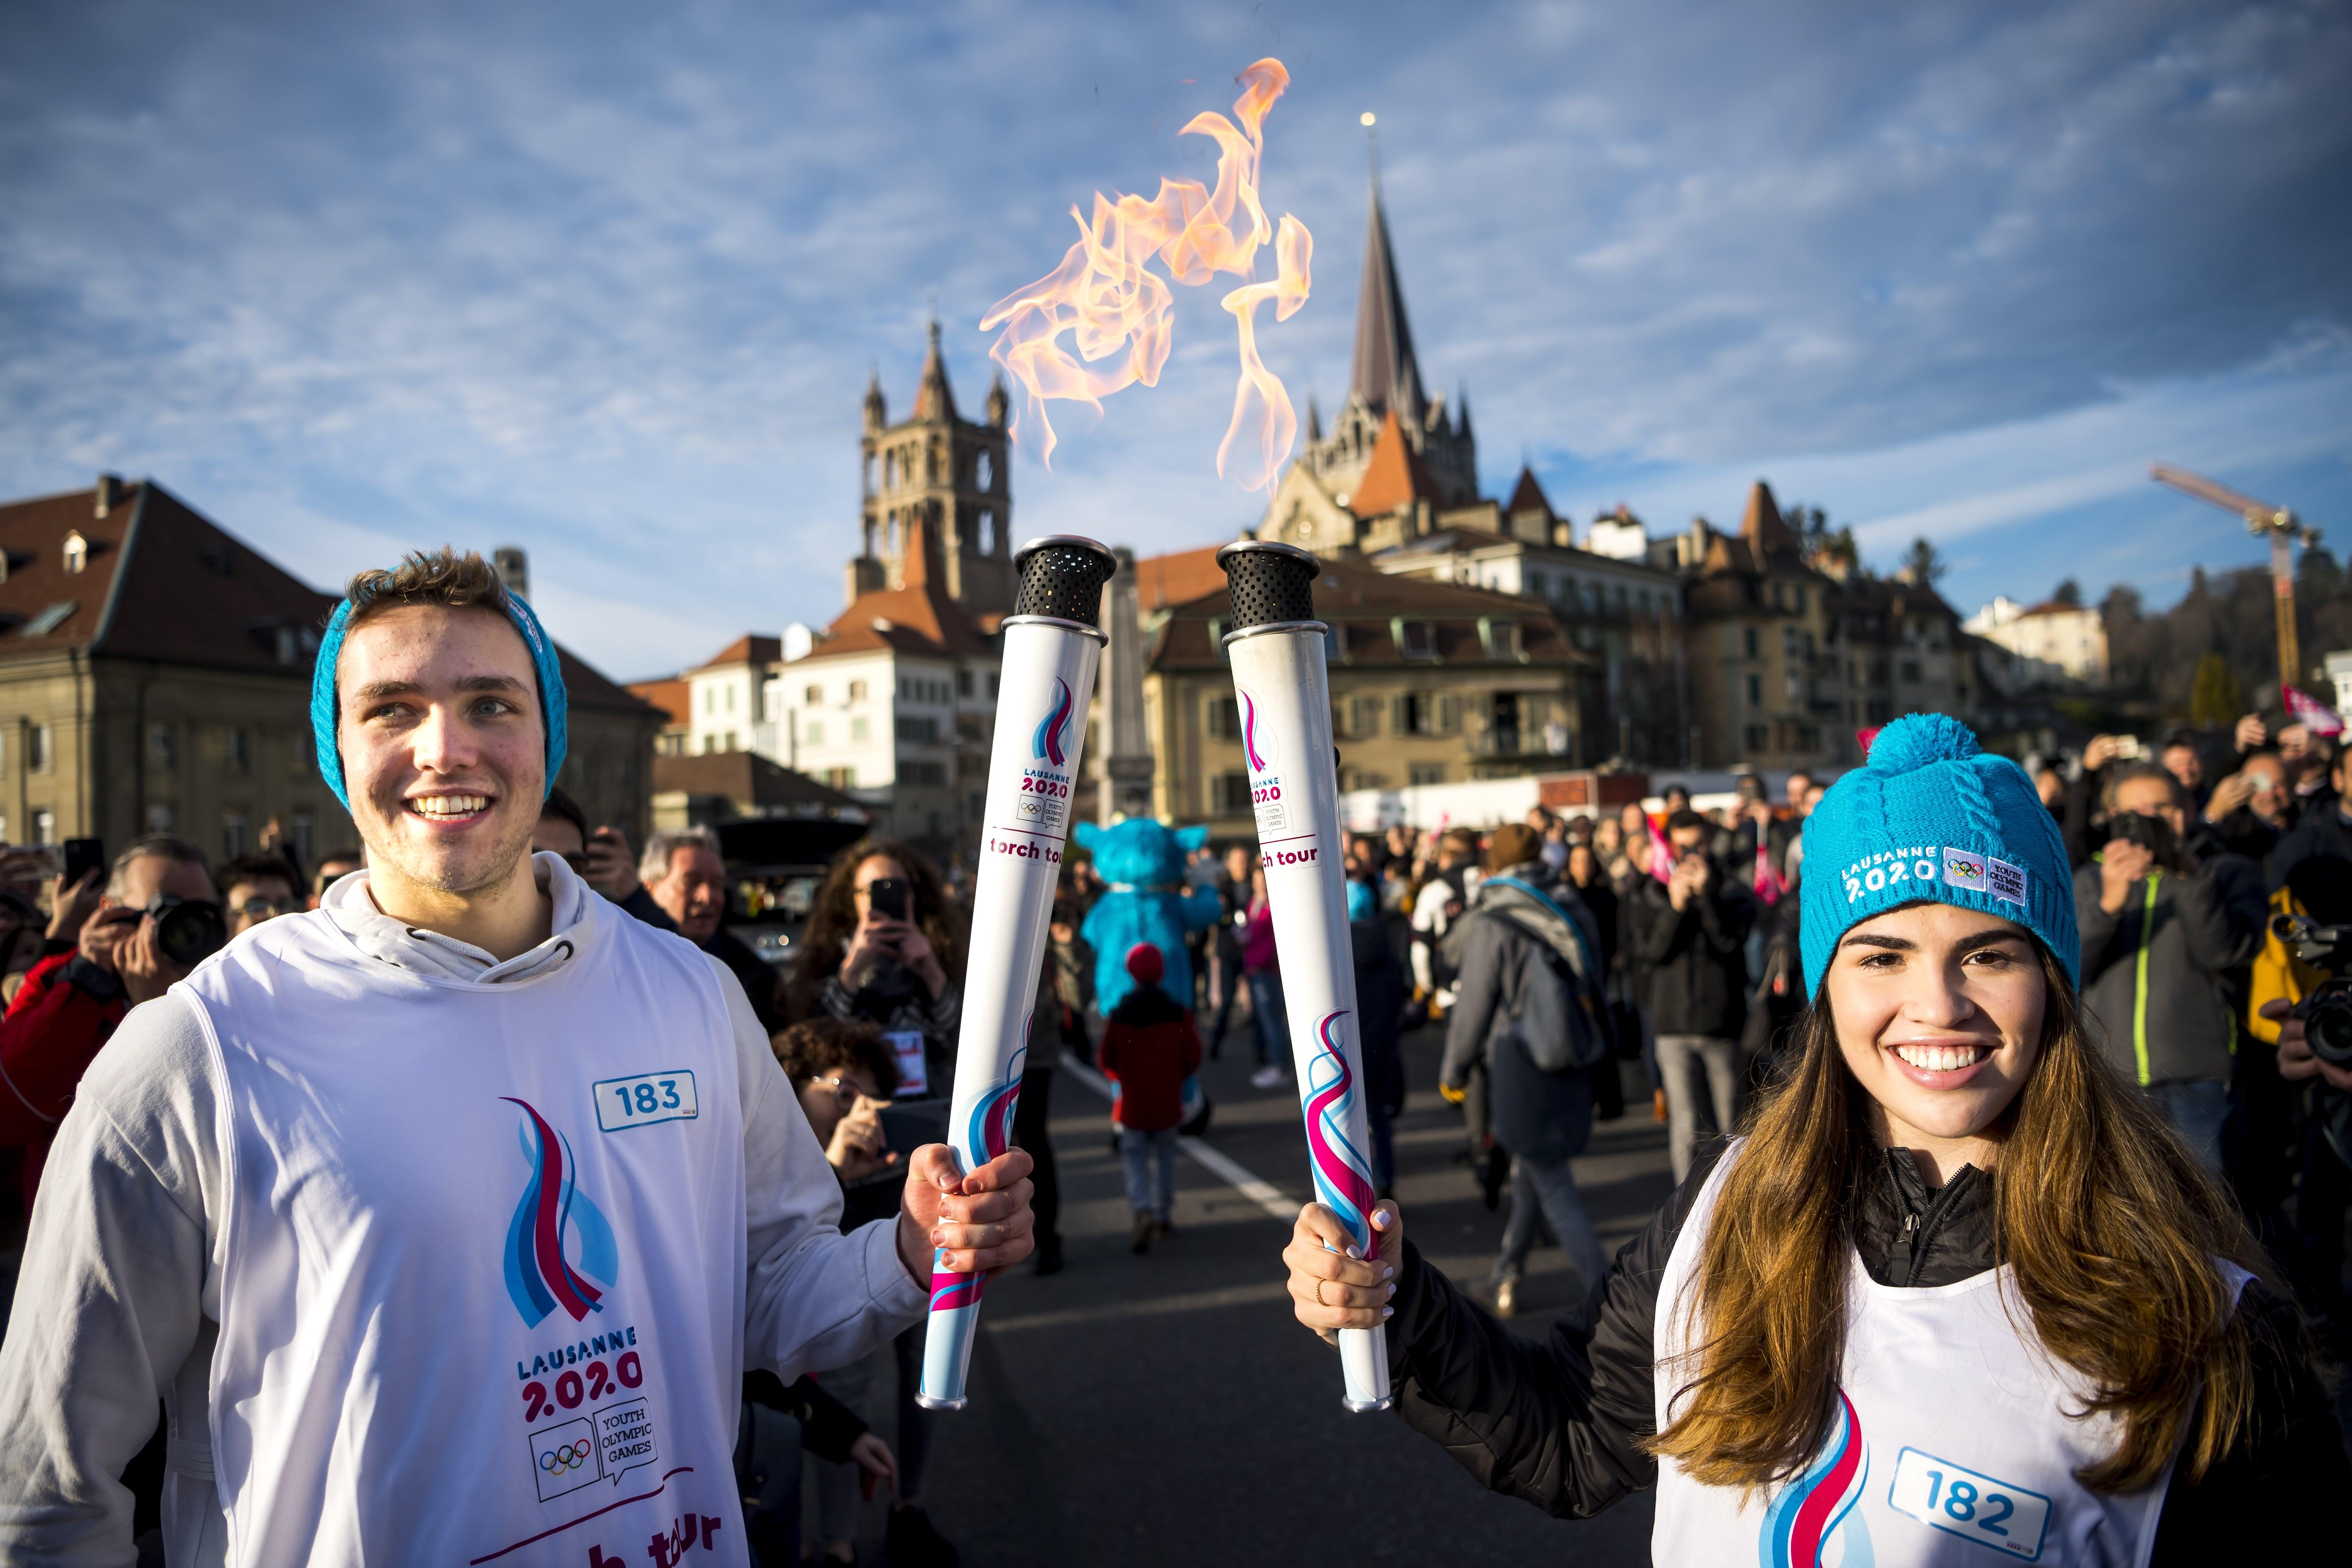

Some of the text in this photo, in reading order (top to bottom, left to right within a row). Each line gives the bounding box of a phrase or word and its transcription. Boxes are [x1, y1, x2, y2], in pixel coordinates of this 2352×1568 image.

[1022, 777, 1067, 798] 2020
[1024, 768, 1070, 784] LAUSANNE
[991, 838, 1062, 864] torch tou
[1277, 848, 1318, 865] tour
[1841, 846, 1936, 880] LAUSANNE
[1990, 872, 2023, 890] OLYMPIC
[1995, 865, 2022, 881] YOUTH
[1994, 882, 2020, 898] GAMES
[615, 1080, 681, 1116] 183
[517, 1326, 637, 1380] LAUSANNE
[522, 1351, 643, 1422] 2020
[603, 1409, 645, 1431] YOUTH
[602, 1422, 652, 1448] OLYMPIC
[608, 1440, 652, 1462] GAMES
[1926, 1470, 2014, 1536] 182
[648, 1514, 721, 1568] tour
